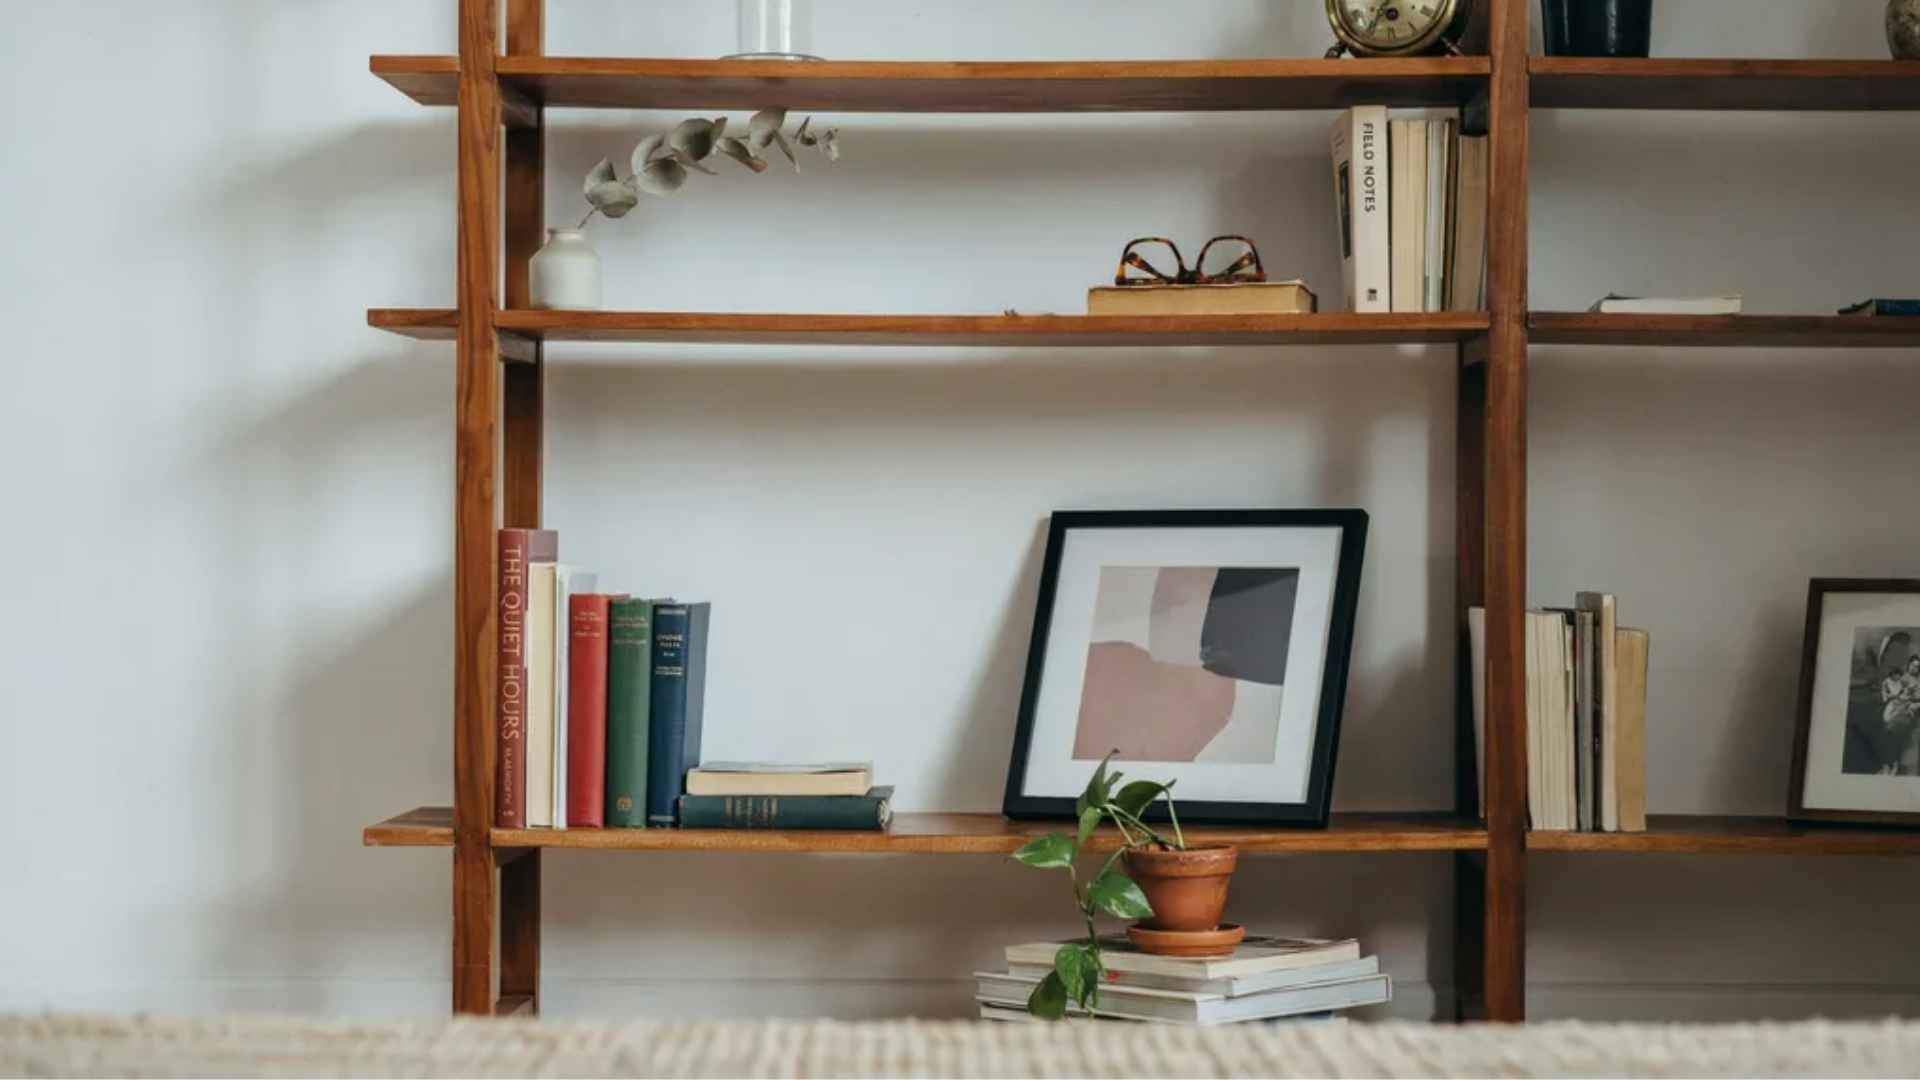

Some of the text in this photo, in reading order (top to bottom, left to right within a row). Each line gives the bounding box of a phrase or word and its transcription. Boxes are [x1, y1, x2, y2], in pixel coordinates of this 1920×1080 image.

[1363, 122, 1376, 213] FIELD NOTES
[501, 545, 522, 739] THE QUIET HOURS
